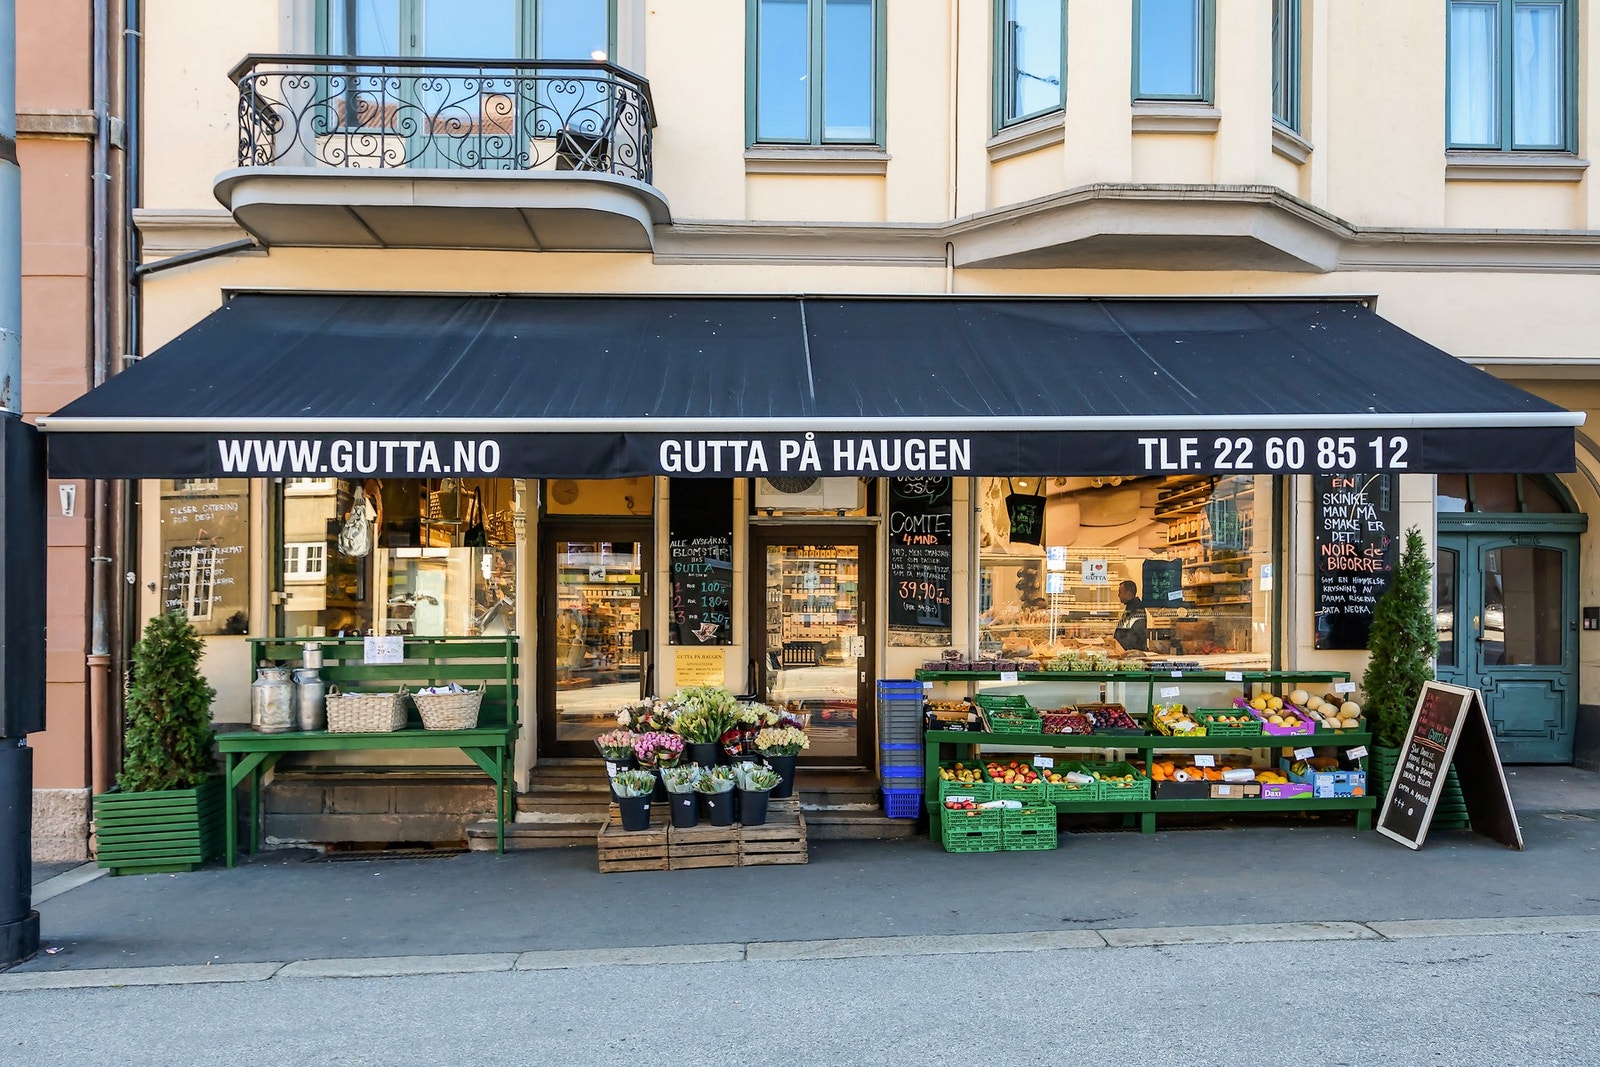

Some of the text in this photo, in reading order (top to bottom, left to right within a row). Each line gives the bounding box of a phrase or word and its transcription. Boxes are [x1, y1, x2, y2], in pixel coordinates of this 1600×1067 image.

[218, 439, 500, 473] WWW.GUTTA.NO
[660, 432, 971, 472] GUTTA PÅ HAUGEN
[1138, 436, 1409, 470] TLF. 22 60 85 12
[1323, 503, 1377, 521] MAN MÅ
[890, 511, 951, 533] COMTE
[1324, 518, 1386, 532] SMAKE ER
[670, 539, 688, 548] ALLE
[903, 533, 912, 546] 4
[673, 547, 729, 558] BLOMSTER
[1321, 542, 1358, 557] NOIR
[675, 562, 715, 574] GUTTA
[1327, 557, 1384, 574] BIGORRE
[1321, 576, 1333, 584] SOM
[1362, 586, 1373, 594] AV
[674, 595, 685, 608] 2
[1321, 594, 1346, 603] PARMA
[1321, 605, 1340, 614] PATA
[676, 610, 686, 625] 3
